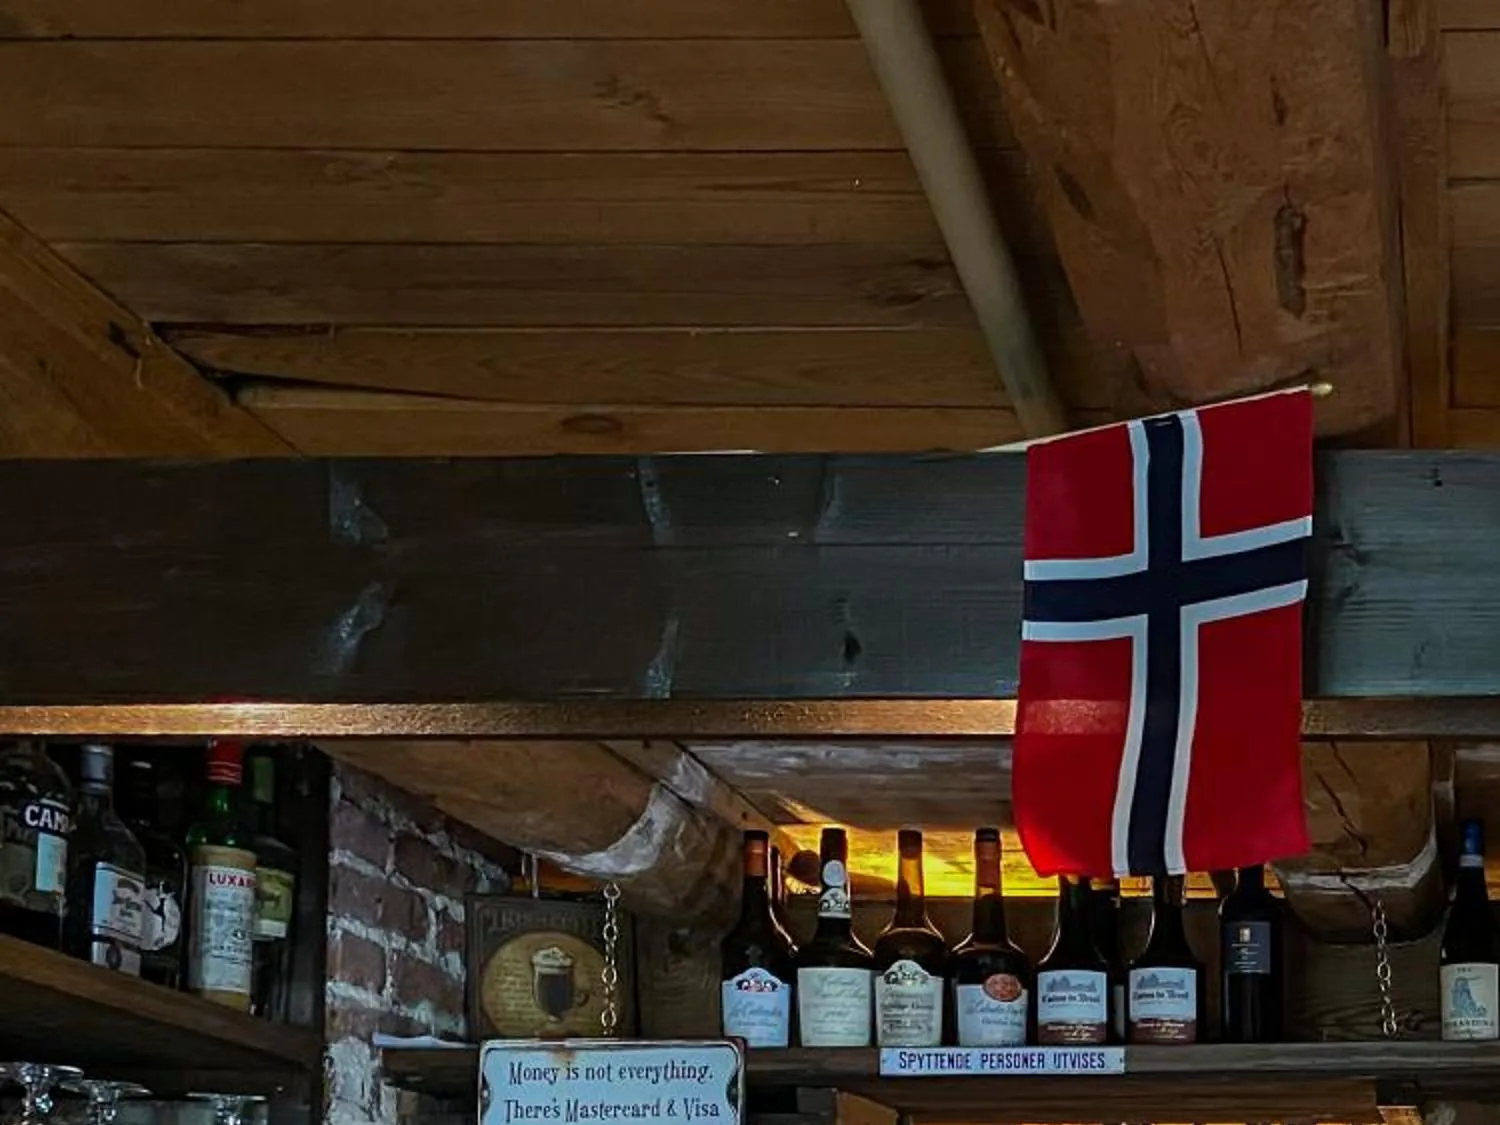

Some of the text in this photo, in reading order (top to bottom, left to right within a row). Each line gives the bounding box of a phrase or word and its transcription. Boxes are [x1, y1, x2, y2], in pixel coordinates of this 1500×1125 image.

[509, 1060, 714, 1085] Money is not everything.
[899, 1051, 1105, 1070] SPYTTENDE PERSONER UTVISES
[504, 1097, 720, 1125] There's Mastercard & Visa
